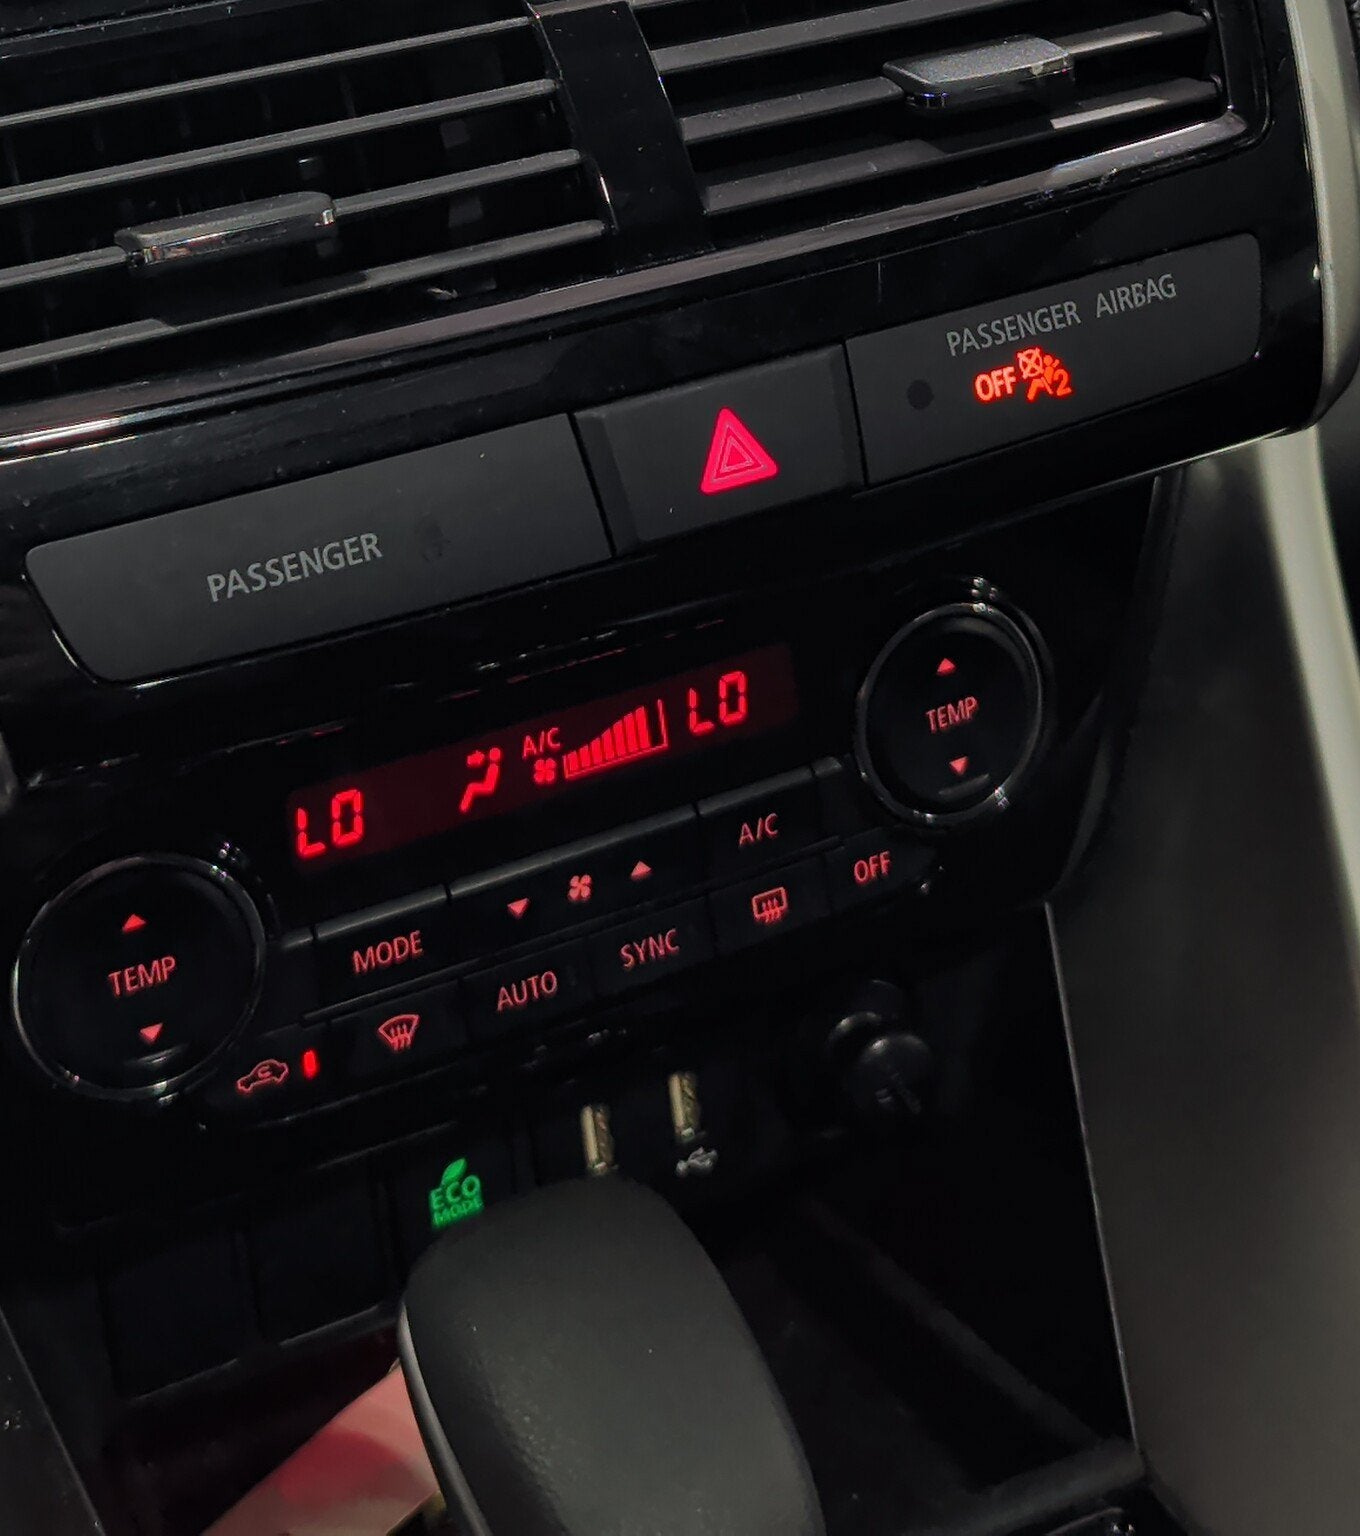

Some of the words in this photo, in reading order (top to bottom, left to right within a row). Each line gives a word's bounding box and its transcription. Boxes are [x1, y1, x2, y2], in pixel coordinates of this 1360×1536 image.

[945, 301, 1081, 357] PASSENGER
[1095, 273, 1177, 319] AIRBAG
[973, 365, 1017, 401] OFF
[206, 532, 383, 602] PASSENGER
[688, 670, 747, 734] LO
[926, 696, 979, 734] TEMP
[522, 727, 561, 759] A/C
[296, 788, 364, 859] LO
[738, 813, 779, 848] A/C
[853, 851, 892, 884] OFF
[352, 930, 423, 974] MODE
[620, 928, 680, 968] SYNC
[108, 955, 177, 997] TEMP
[497, 970, 558, 1011] AUTO
[430, 1174, 481, 1210] ECO
